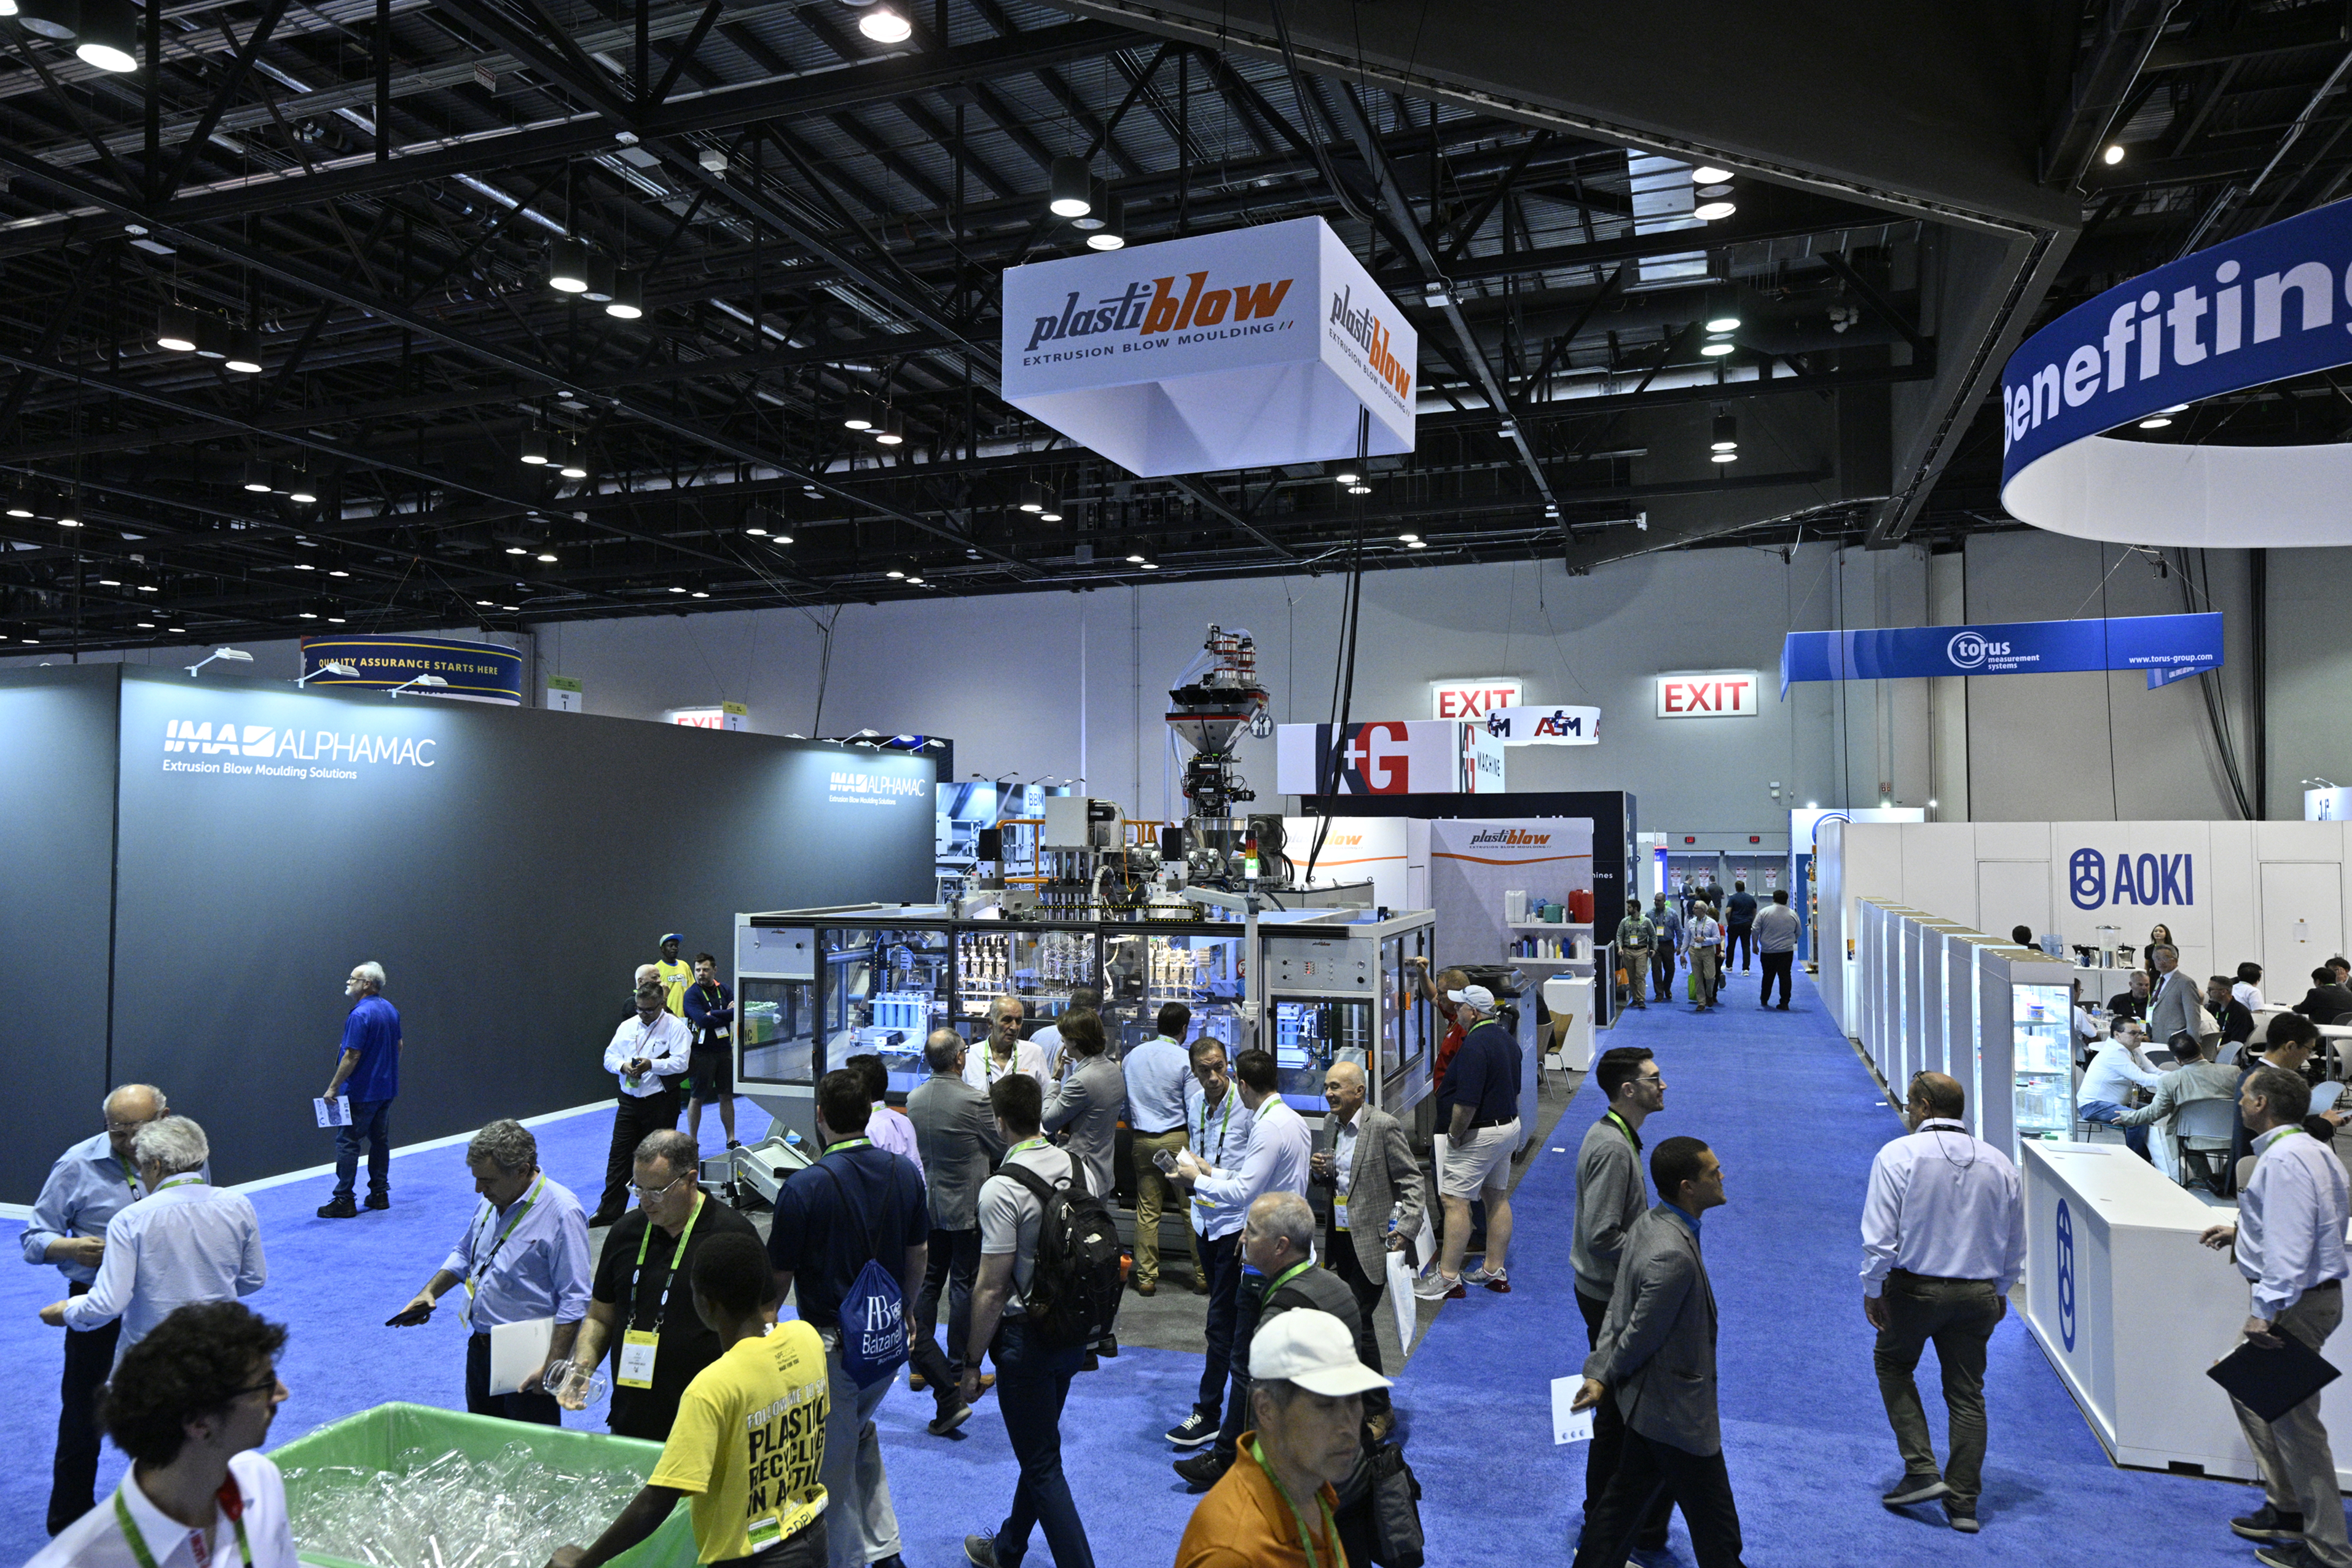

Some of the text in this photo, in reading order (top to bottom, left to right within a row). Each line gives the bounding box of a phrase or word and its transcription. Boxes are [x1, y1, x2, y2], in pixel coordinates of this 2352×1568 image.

[1024, 270, 1294, 352] plastiblow
[1023, 345, 1115, 367] EXTRUSION
[1123, 338, 1170, 353] BLOW
[1328, 327, 1362, 369] EXTRUSION
[1363, 364, 1379, 385] BLOW
[1330, 284, 1411, 401] plastiblow
[2004, 260, 2352, 460] Benefitin
[1959, 641, 2011, 657] torus
[1988, 654, 2040, 663] measurement
[2129, 654, 2213, 664] www.torus-group.com
[360, 657, 431, 669] ASSURANCE
[434, 661, 474, 673] STARTS
[477, 665, 498, 675] HERE
[563, 700, 566, 710] 1
[1440, 689, 1515, 718] EXIT
[1664, 681, 1749, 713] EXIT
[163, 719, 437, 767] IMA ALPHAMAC
[162, 759, 358, 780] Extrusion Blow Moulding Solutions
[1477, 750, 1500, 777] MACHINE
[829, 772, 925, 797] IMA ALPHAMAC
[829, 794, 849, 803] Extrusion
[860, 796, 879, 806] Moulding
[1029, 793, 1044, 806] BBM
[1469, 829, 1551, 845] plastiblow
[2112, 853, 2193, 907] AOKI
[862, 1321, 903, 1355] Balzane
[747, 1395, 788, 1430] FOLLOW
[788, 1388, 802, 1406] ME
[804, 1382, 815, 1400] TO
[748, 1395, 825, 1464] PLASTIC
[749, 1427, 825, 1492] RECYCLIG
[747, 1485, 767, 1519] IN
